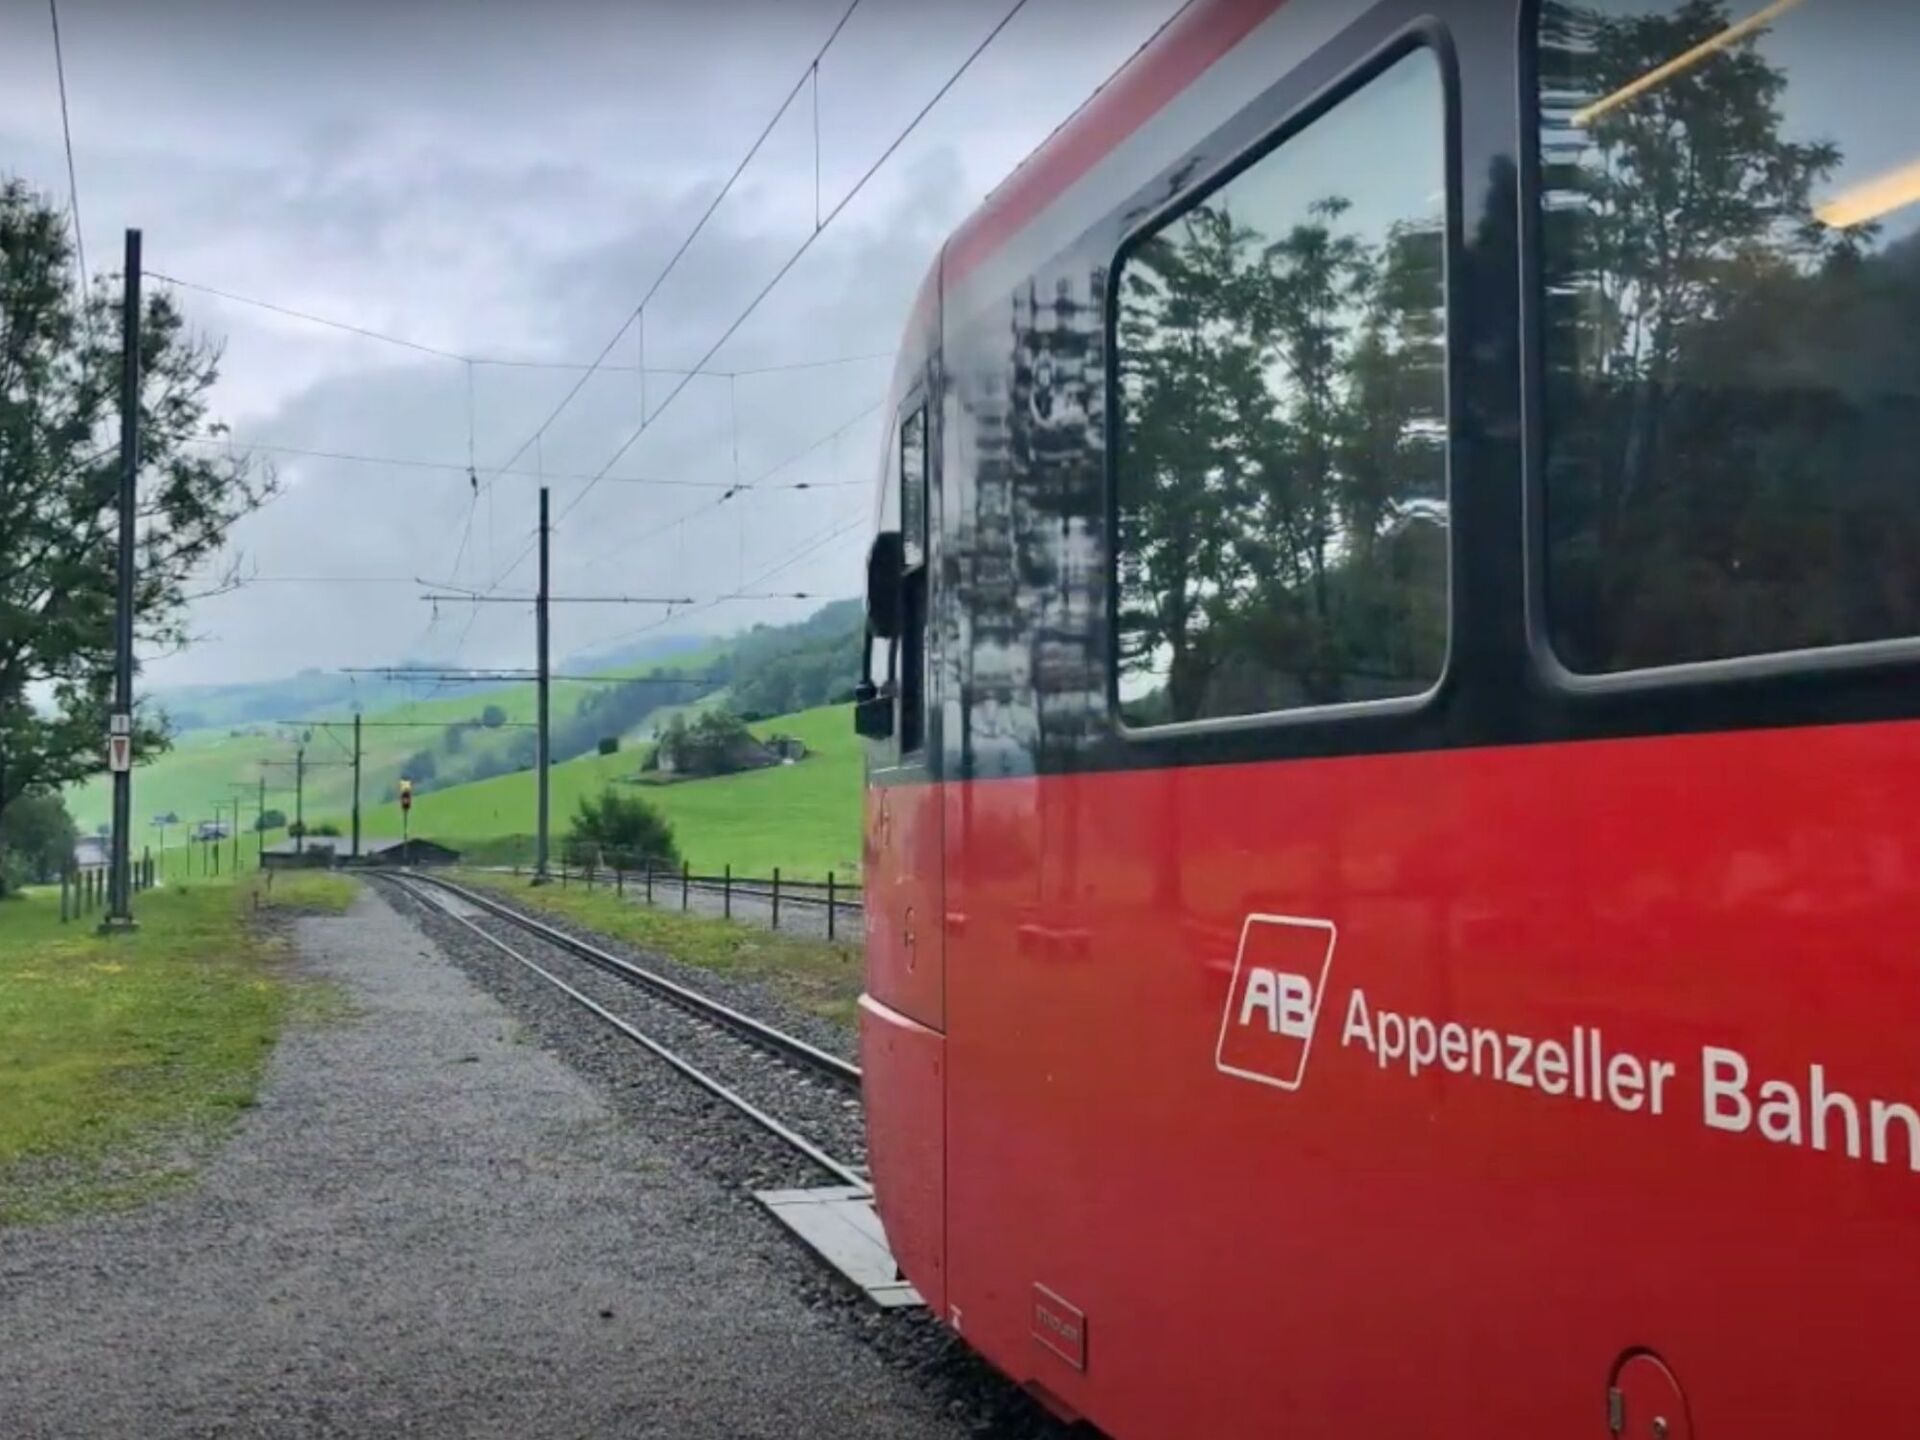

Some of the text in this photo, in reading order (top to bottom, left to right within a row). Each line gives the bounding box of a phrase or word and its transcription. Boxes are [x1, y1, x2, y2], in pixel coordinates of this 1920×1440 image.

[1239, 967, 1315, 1039] AB
[1341, 988, 1920, 1173] Appenzeller Bahn
